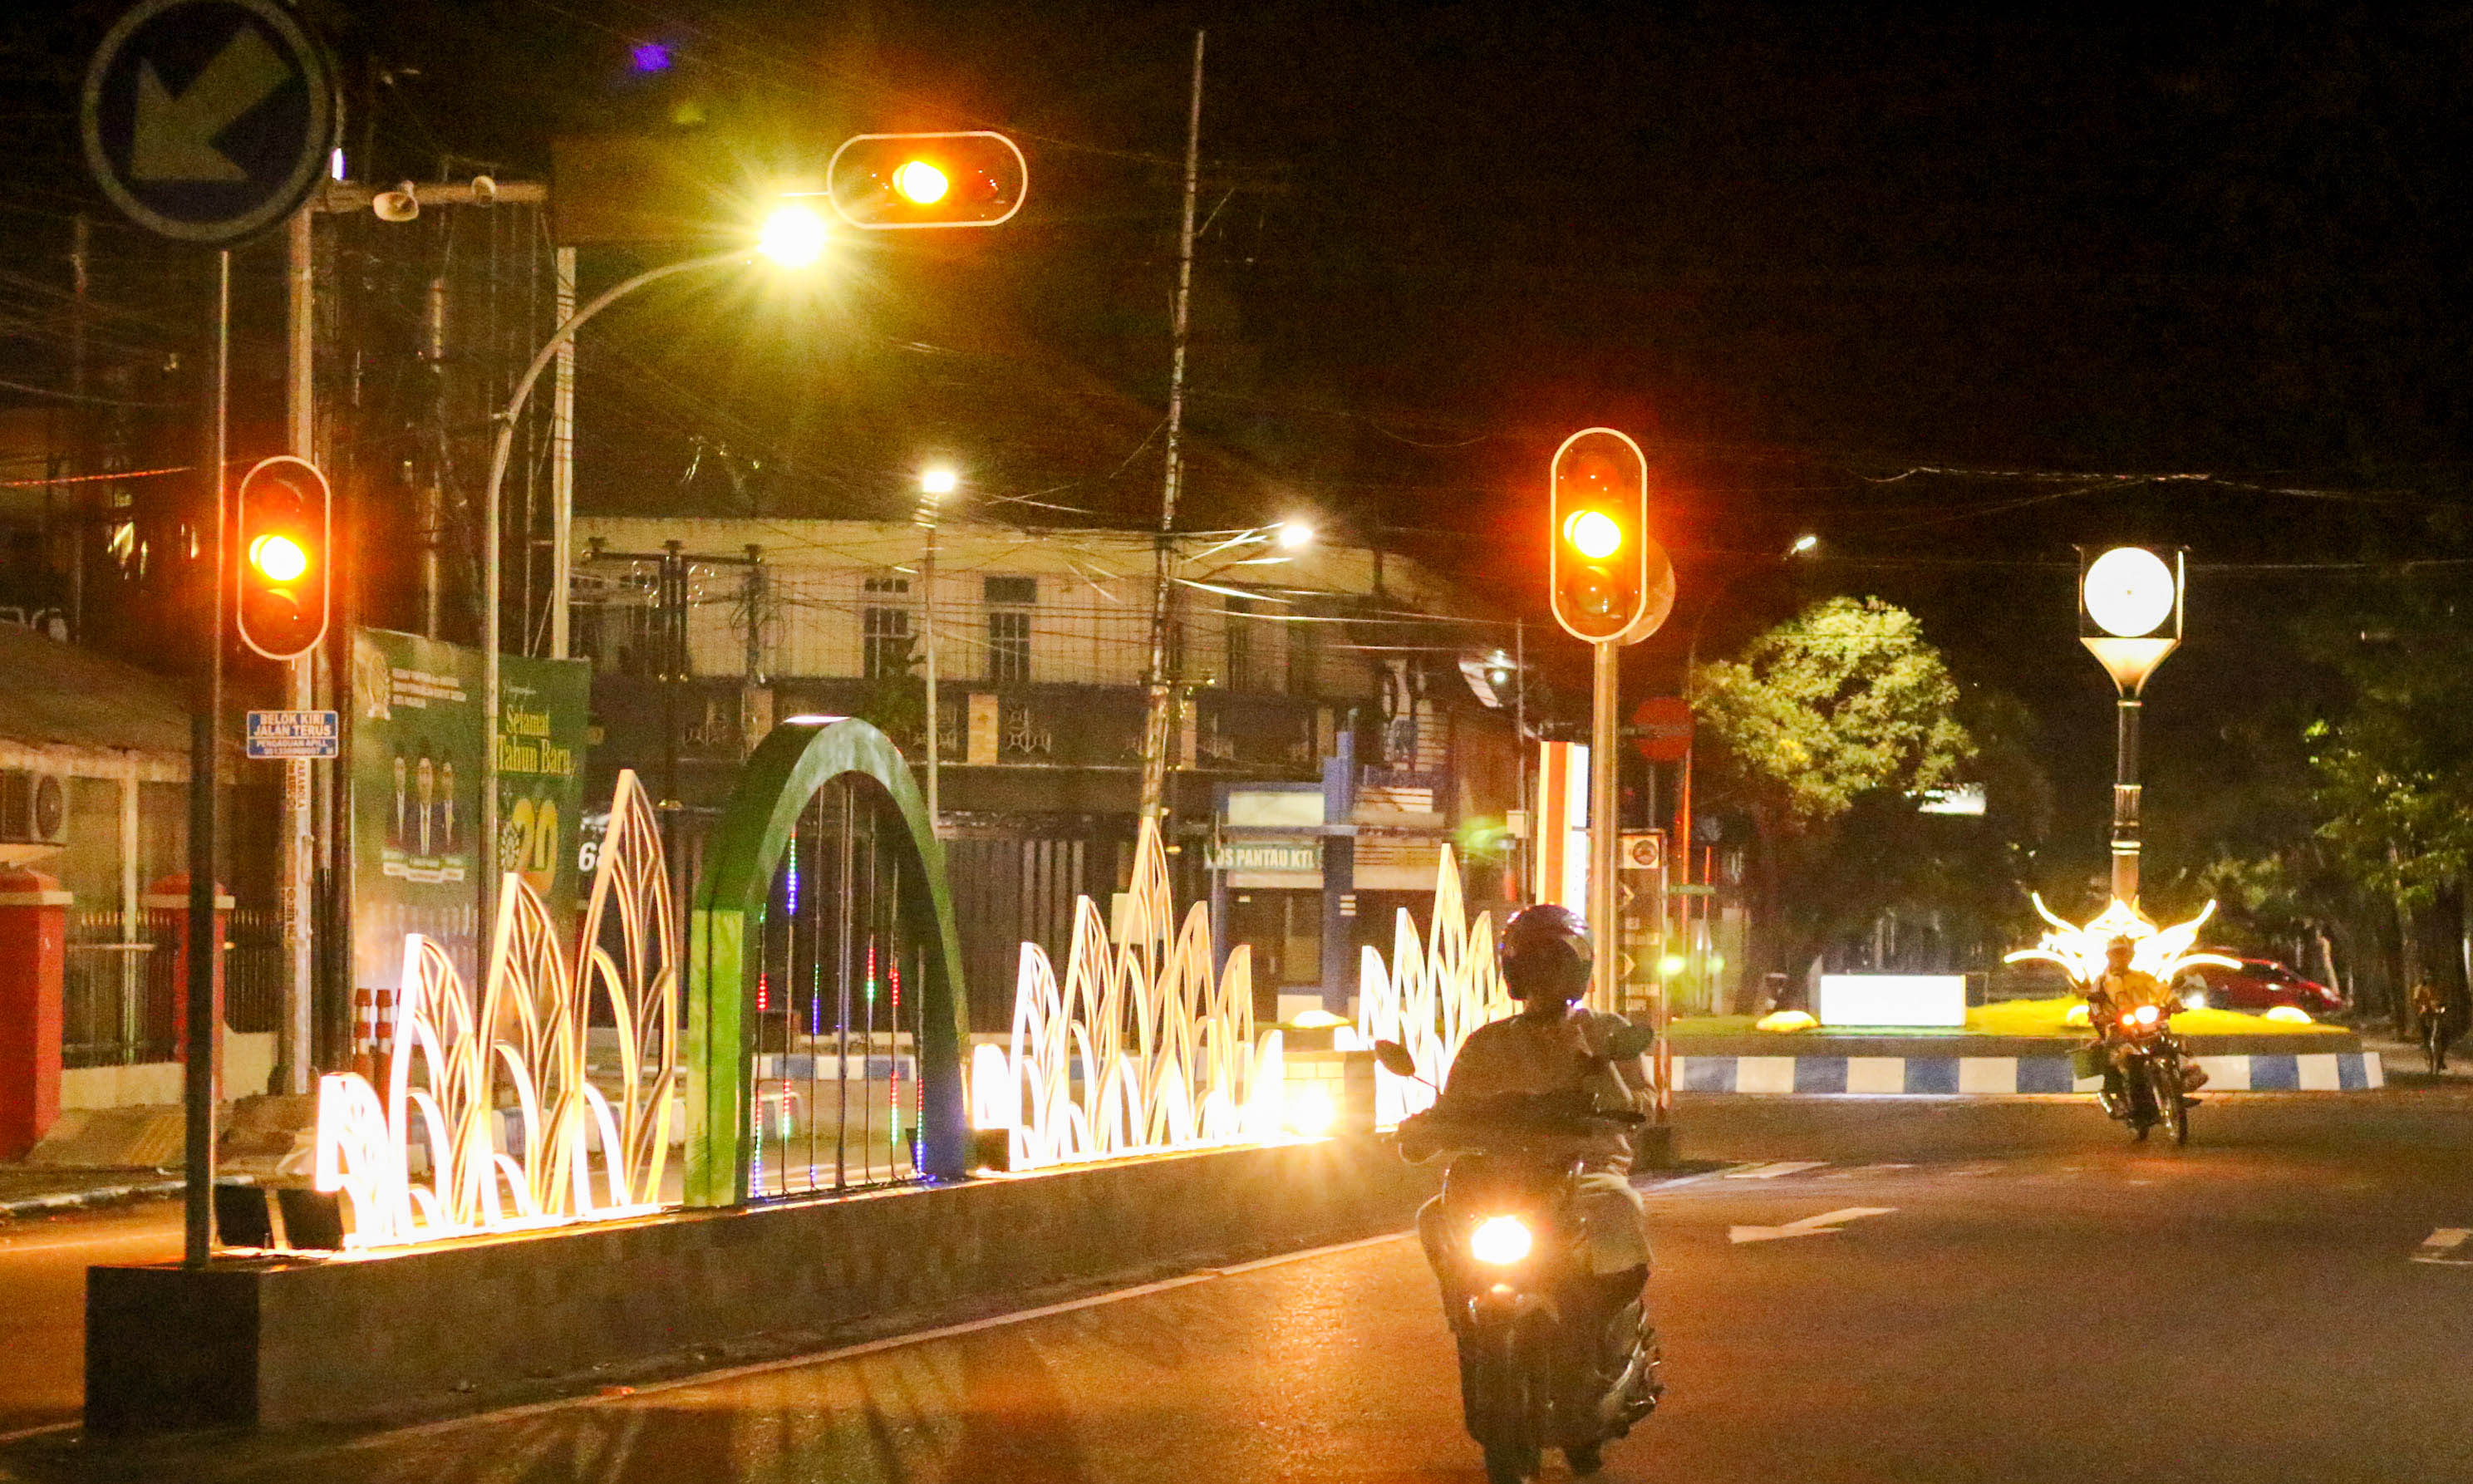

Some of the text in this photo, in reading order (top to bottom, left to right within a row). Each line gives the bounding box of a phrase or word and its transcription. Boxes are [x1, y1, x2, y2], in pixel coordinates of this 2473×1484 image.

[259, 714, 325, 725] BELOK KIRI
[506, 704, 550, 736] Selamat
[253, 725, 331, 736] JALAN TERUS
[497, 735, 538, 773] Tahun
[1236, 848, 1288, 867] PANTAU
